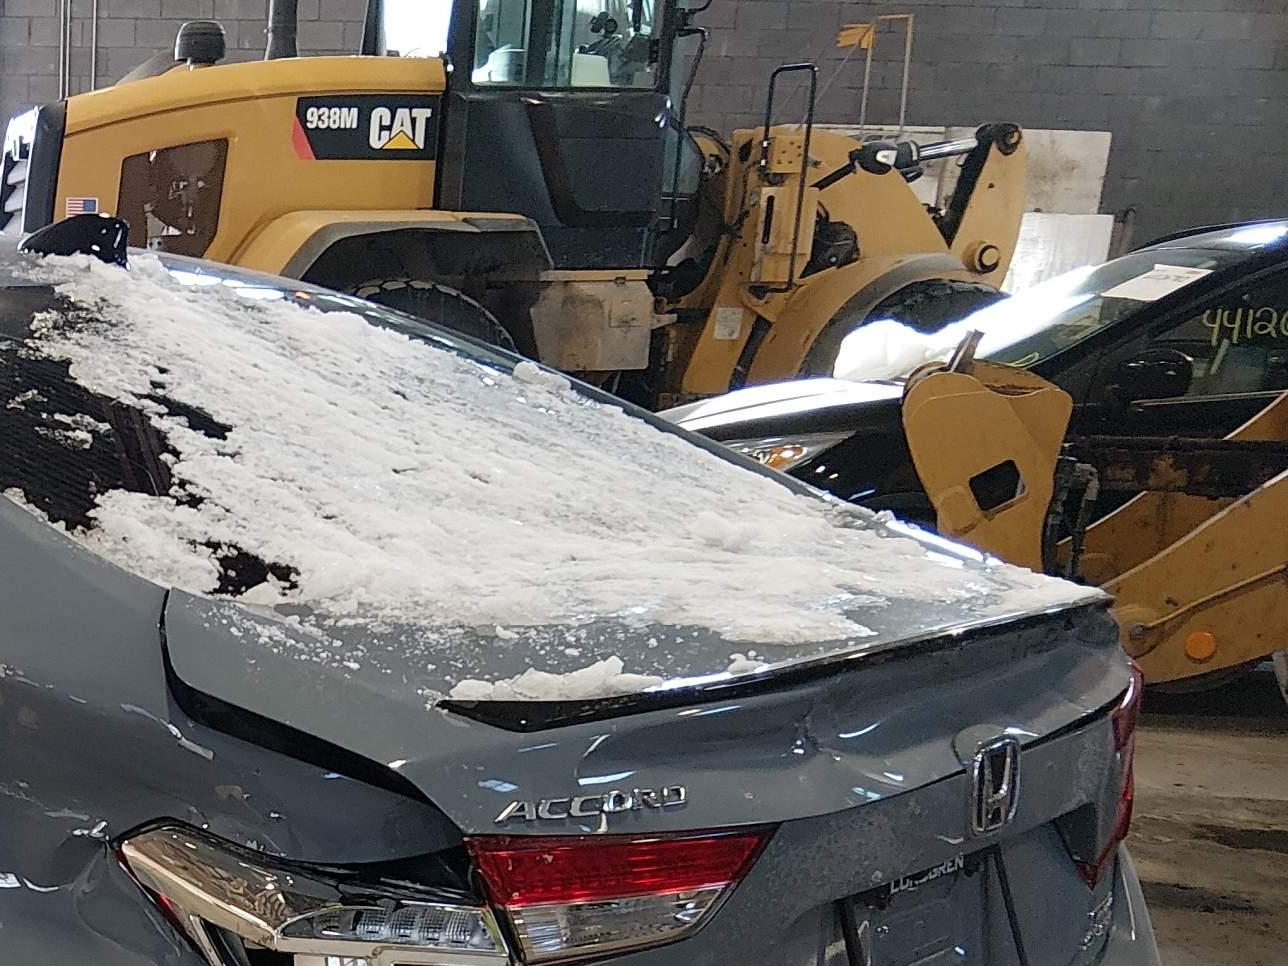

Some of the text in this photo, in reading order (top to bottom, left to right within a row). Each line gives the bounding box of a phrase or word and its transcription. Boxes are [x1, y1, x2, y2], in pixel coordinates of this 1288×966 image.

[306, 106, 432, 150] 938M CAT
[494, 785, 686, 823] ACCORD
